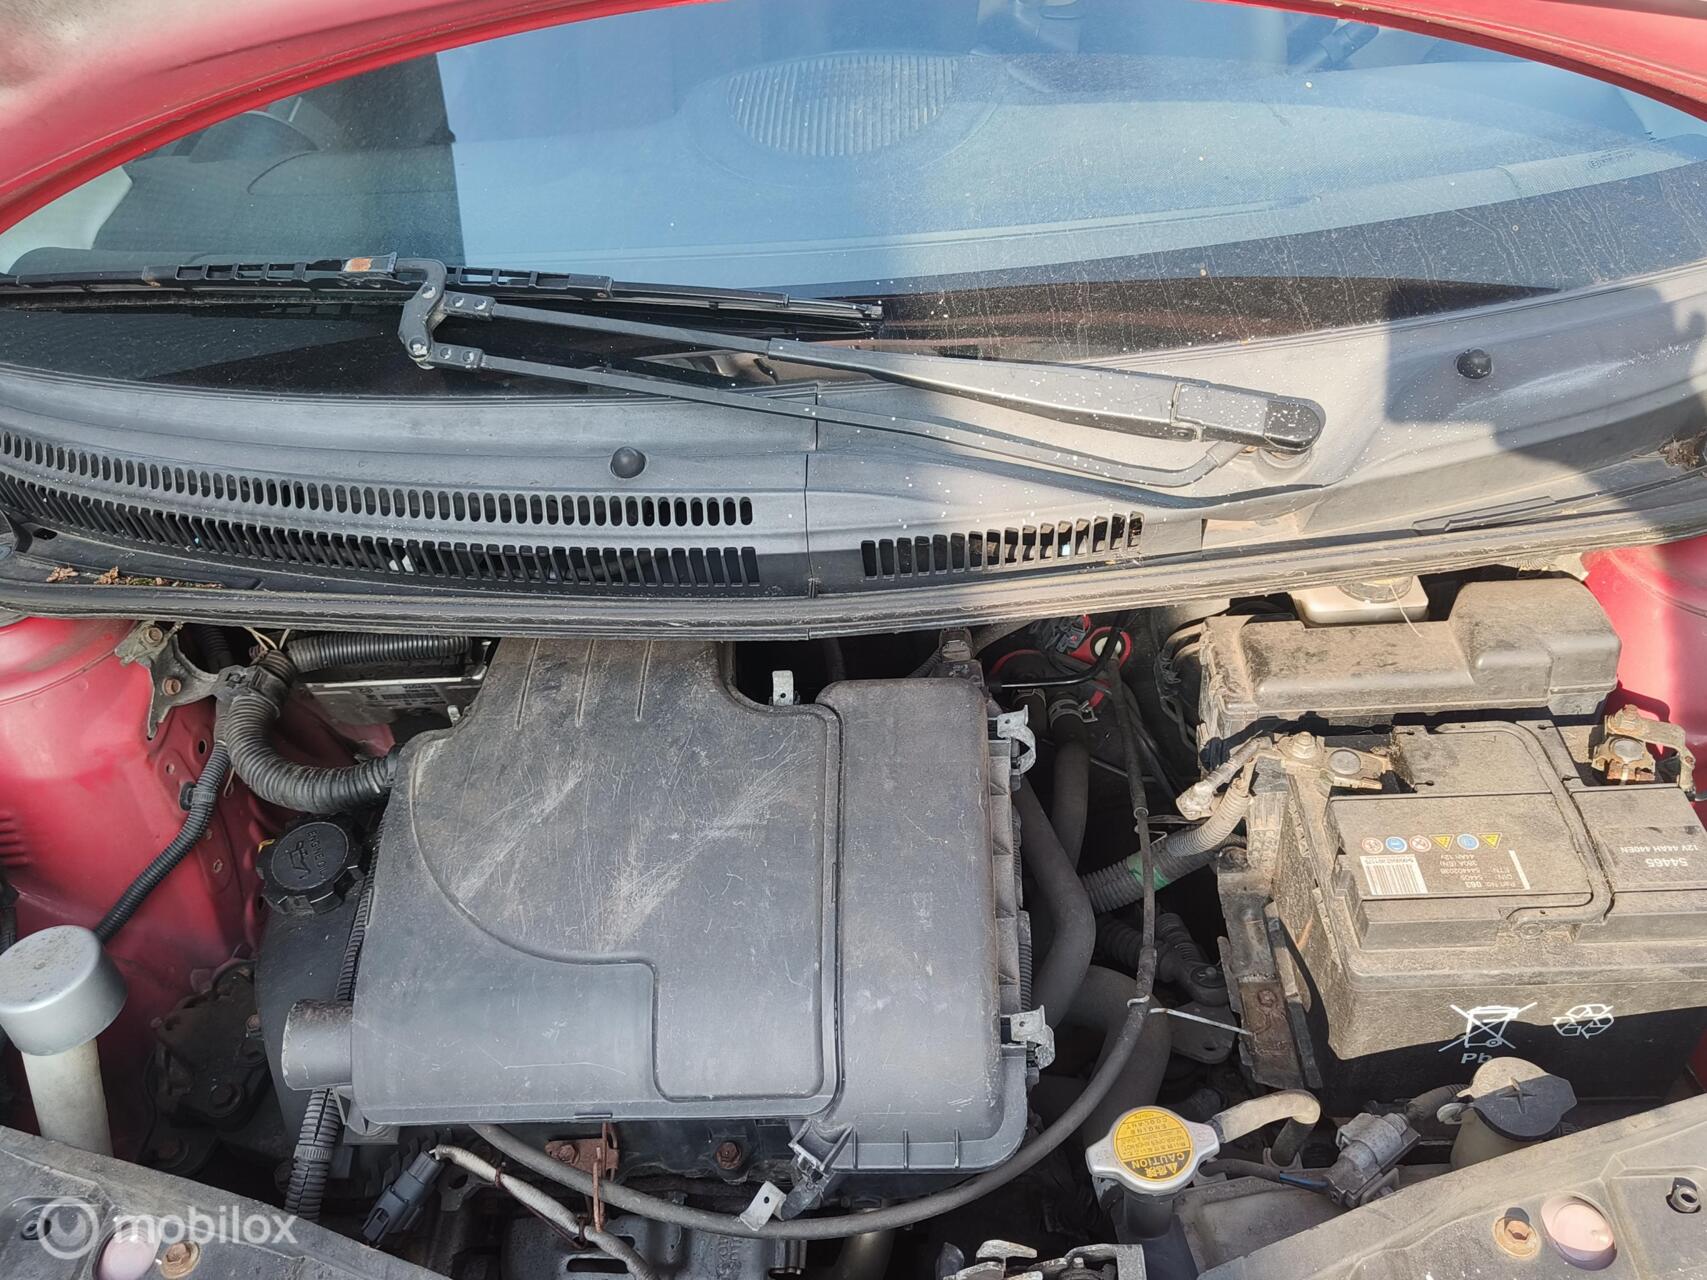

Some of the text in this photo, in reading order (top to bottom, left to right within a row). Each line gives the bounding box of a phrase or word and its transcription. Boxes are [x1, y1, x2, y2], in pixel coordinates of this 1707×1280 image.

[306, 831, 325, 860] ENGINE
[1645, 857, 1689, 867] 54465
[1461, 1052, 1493, 1064] Pb
[1126, 1117, 1167, 1129] COOLANT
[1130, 1124, 1167, 1134] ENGINE
[1131, 1152, 1185, 1169] CAUTION
